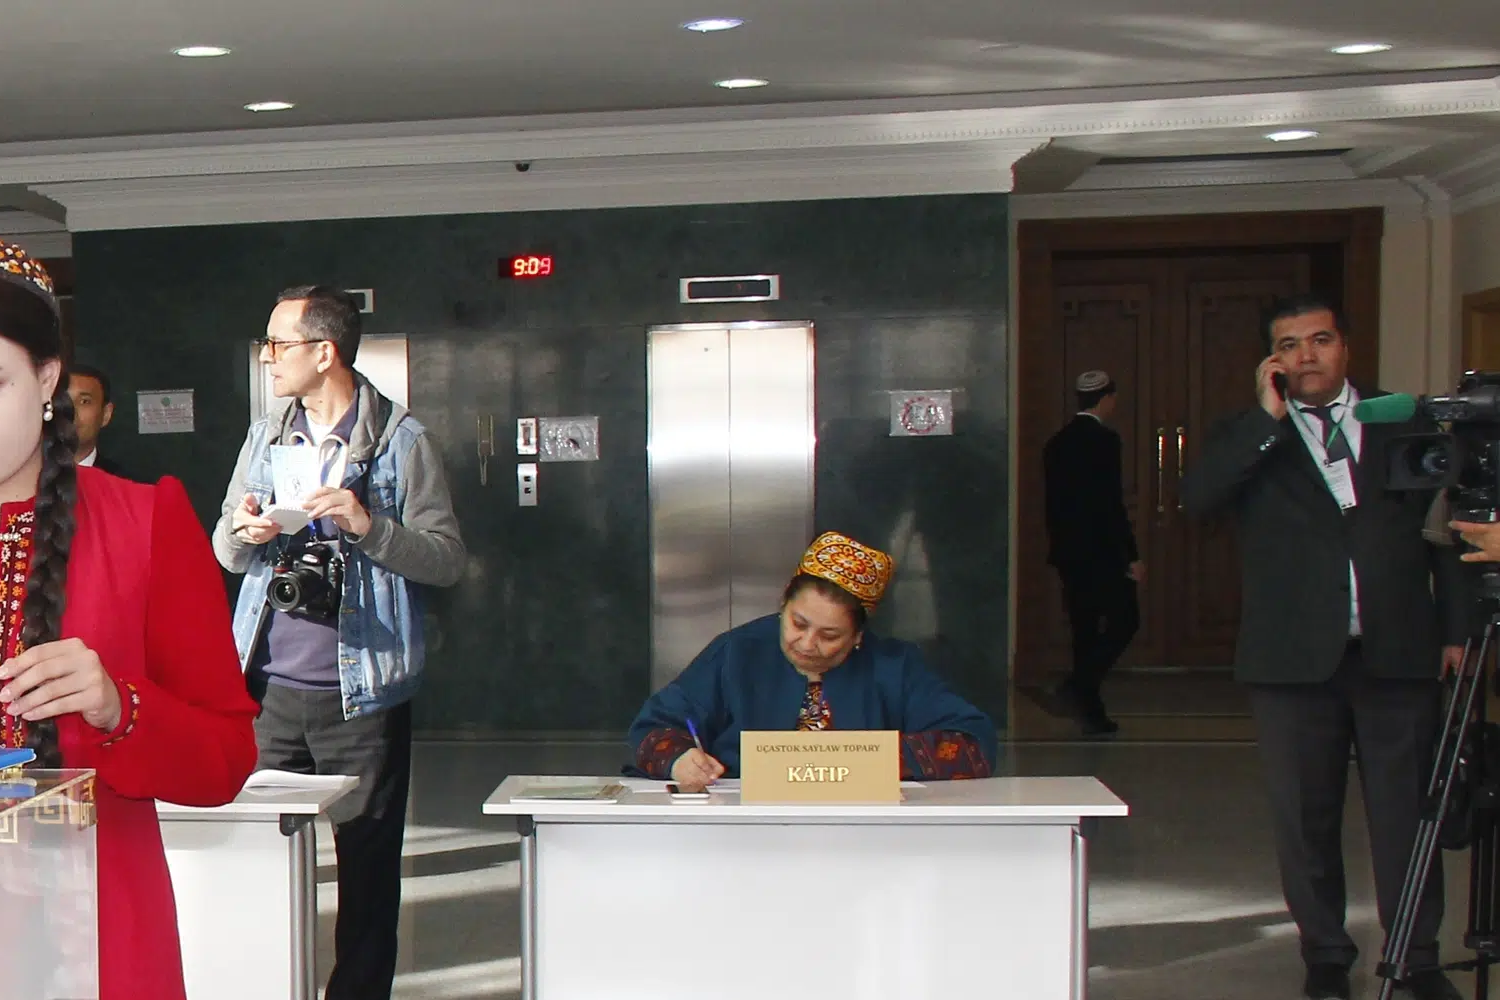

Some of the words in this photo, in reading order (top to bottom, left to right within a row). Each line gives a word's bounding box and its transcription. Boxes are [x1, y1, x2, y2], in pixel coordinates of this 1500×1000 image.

[514, 257, 551, 276] 9:09
[756, 744, 801, 754] UÇASTOK
[843, 744, 880, 753] TOPARY
[787, 763, 850, 783] KÄTIP
